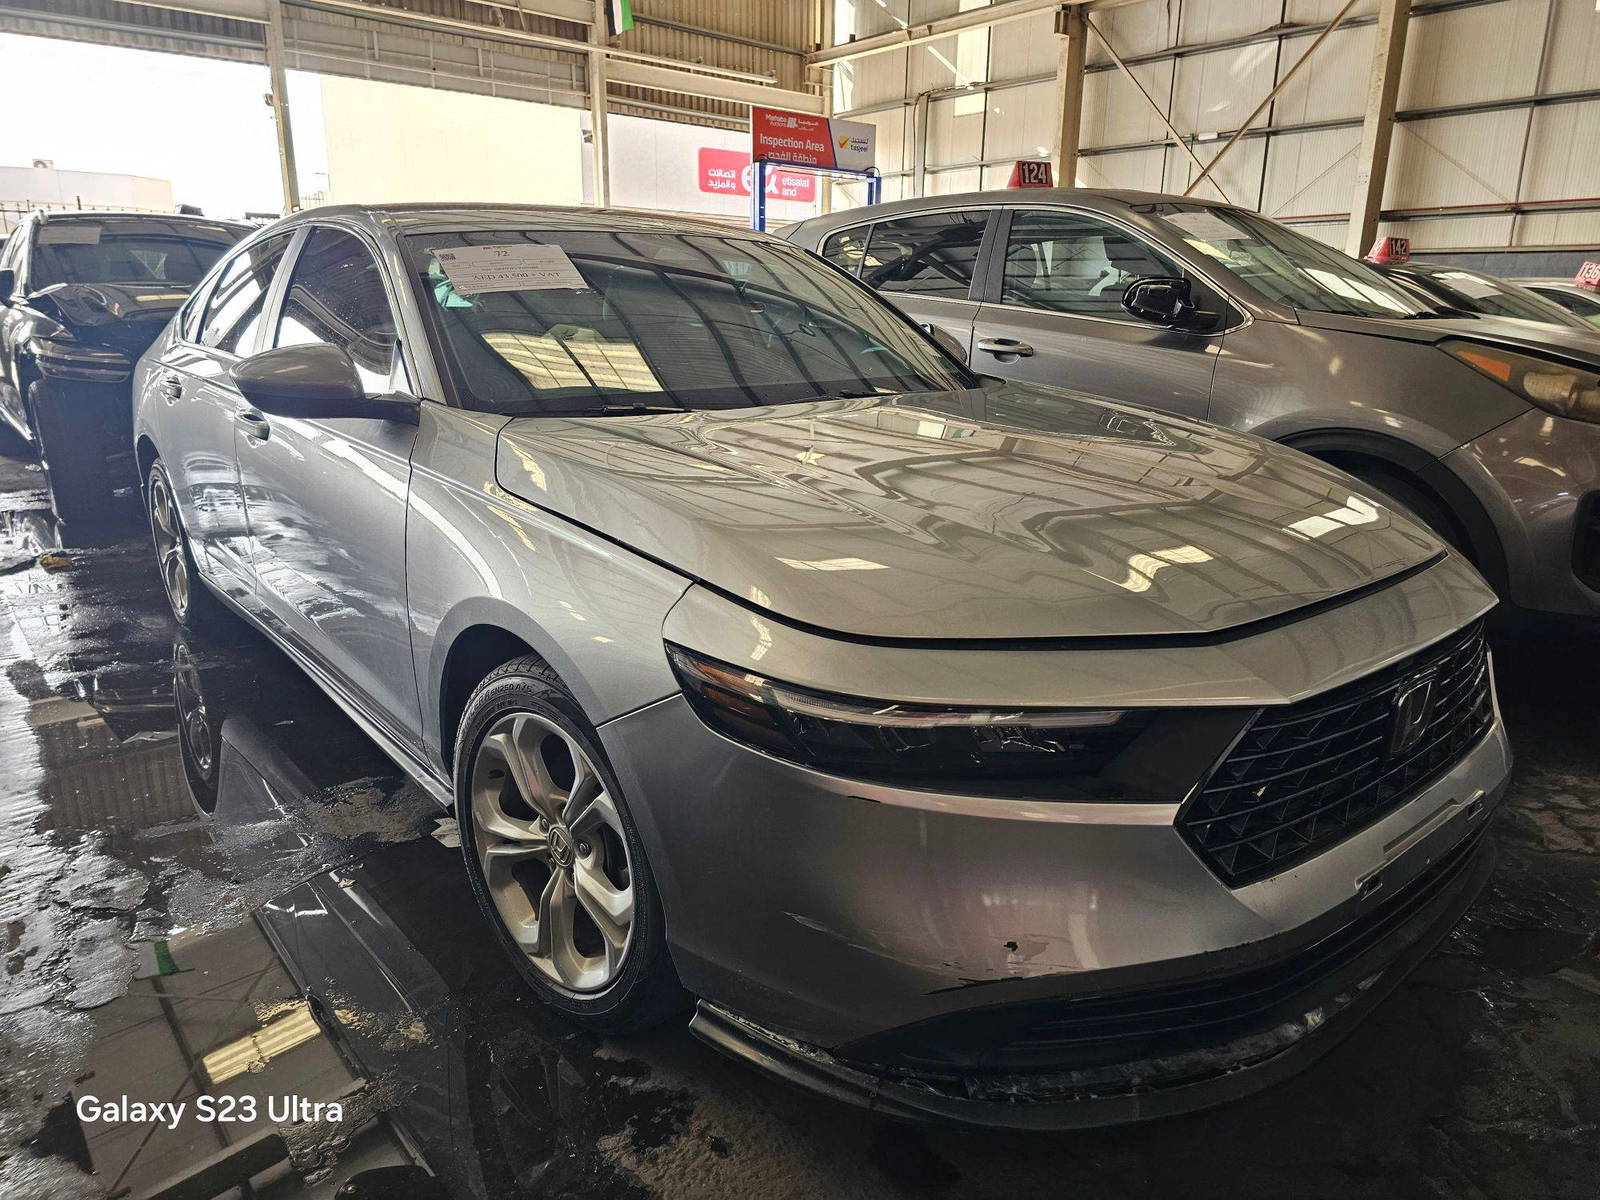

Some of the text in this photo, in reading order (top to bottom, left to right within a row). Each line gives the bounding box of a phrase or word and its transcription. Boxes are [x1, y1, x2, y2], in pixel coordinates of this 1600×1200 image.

[760, 133, 825, 152] Inspection Area
[1023, 162, 1047, 184] 124
[782, 176, 811, 188] etisalat
[782, 187, 798, 197] and
[1391, 239, 1407, 256] 142
